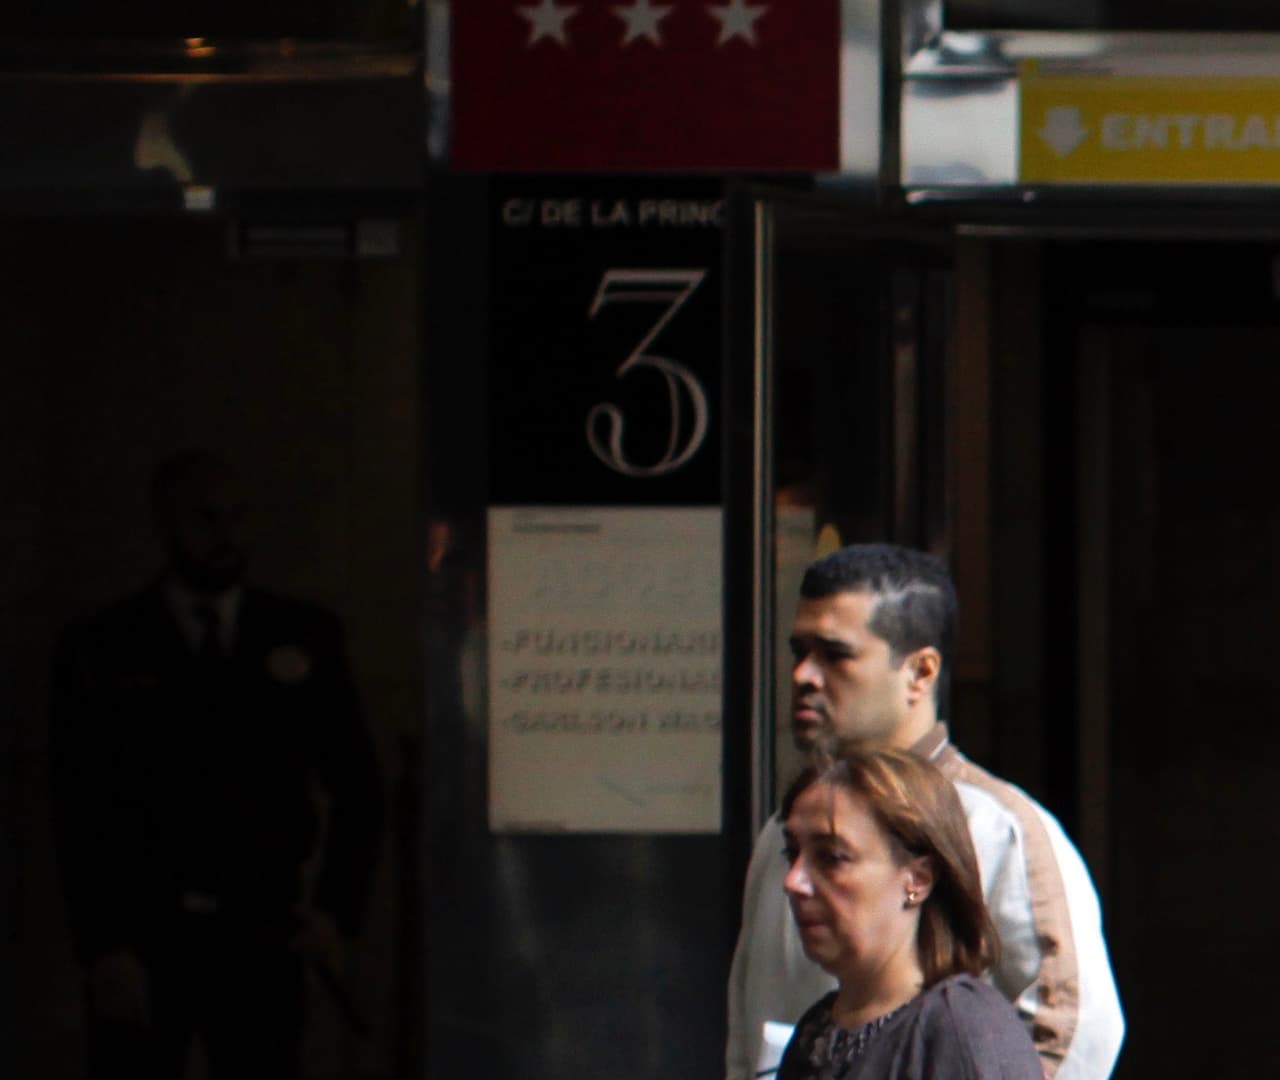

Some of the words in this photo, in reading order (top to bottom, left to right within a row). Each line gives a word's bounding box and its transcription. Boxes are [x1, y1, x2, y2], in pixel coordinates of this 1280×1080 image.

[541, 201, 581, 225] DE
[591, 201, 631, 225] LA
[587, 269, 708, 476] 3
